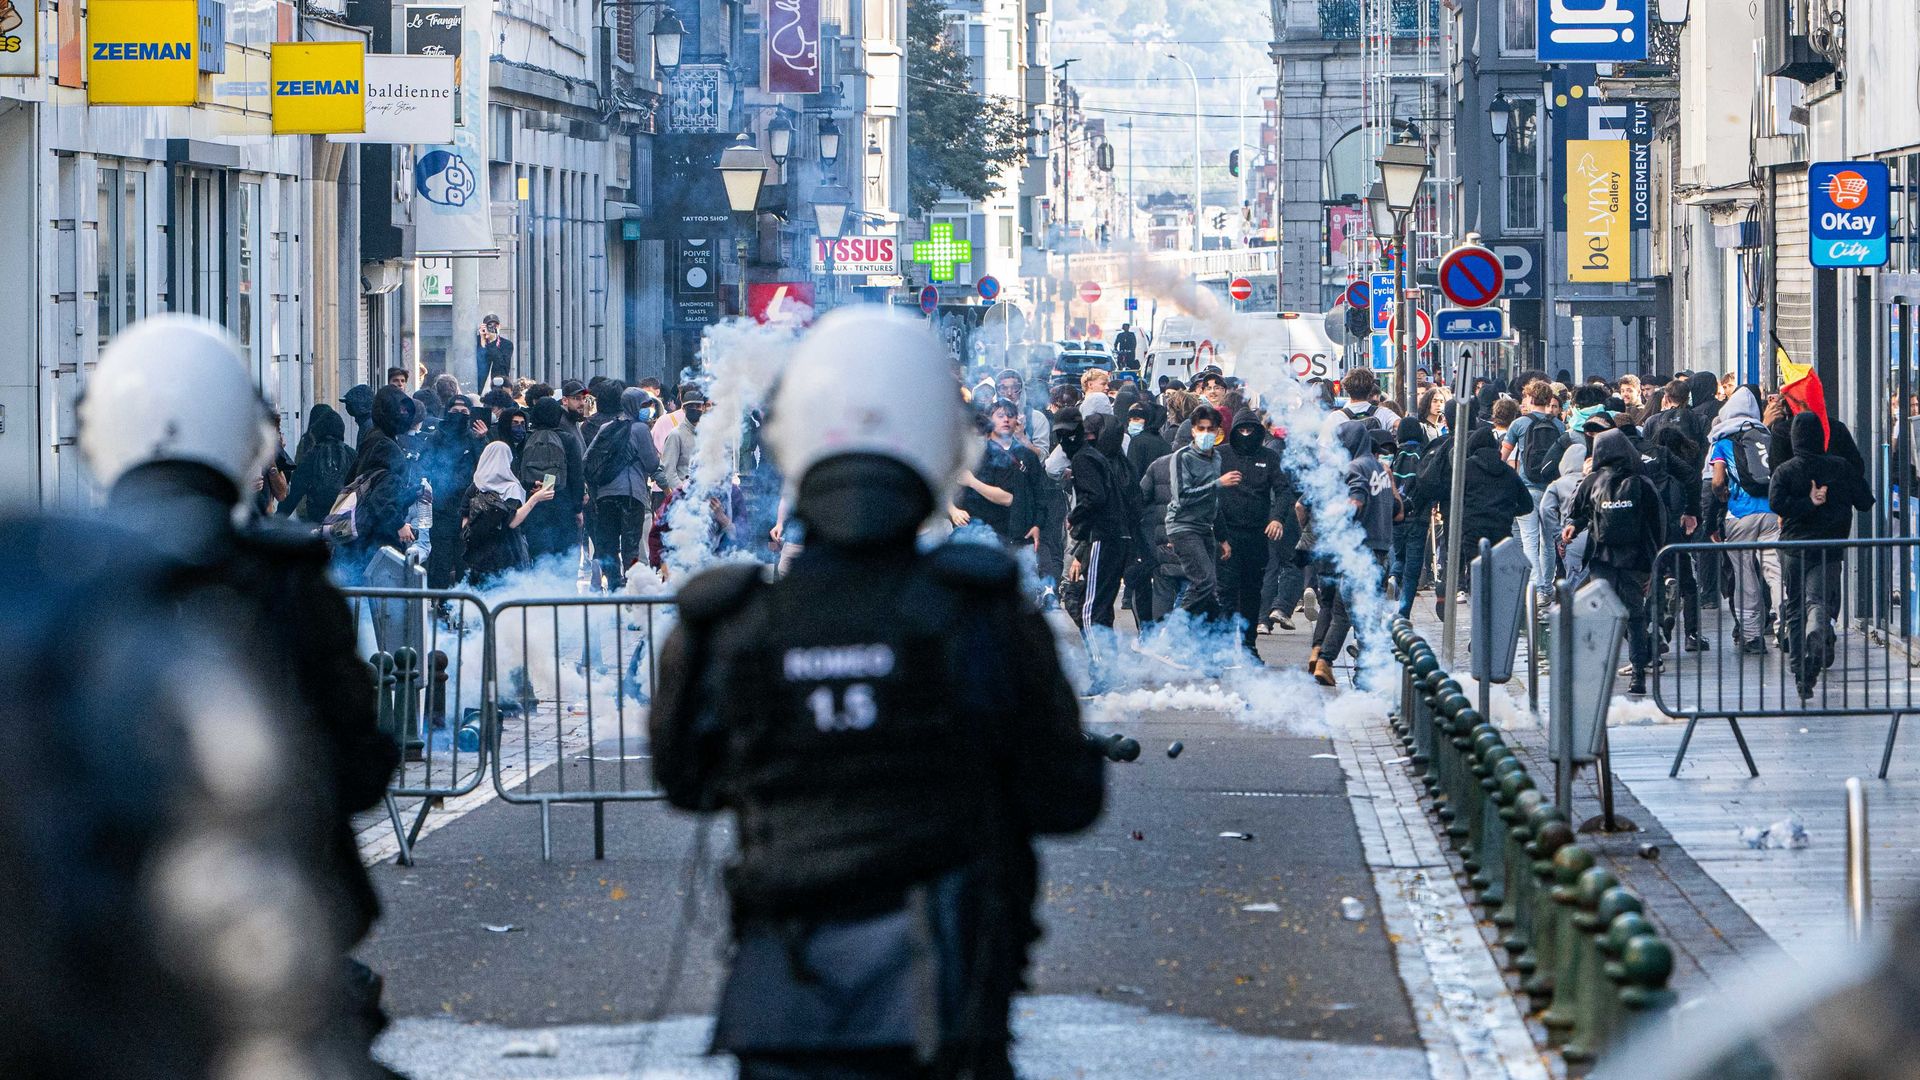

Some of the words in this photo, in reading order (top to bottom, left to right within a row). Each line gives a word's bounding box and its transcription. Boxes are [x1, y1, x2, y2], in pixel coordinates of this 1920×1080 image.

[407, 14, 423, 28] Le
[93, 42, 191, 60] ZEEMAN
[276, 80, 359, 96] ZEEMAN
[368, 84, 449, 98] baldienne
[394, 101, 417, 115] Store
[1635, 143, 1647, 221] LOGEMENT
[1609, 172, 1621, 212] Gallery
[1582, 172, 1615, 270] beLynx
[1821, 212, 1876, 235] OKay
[1829, 241, 1870, 262] City
[1374, 287, 1394, 296] cycla
